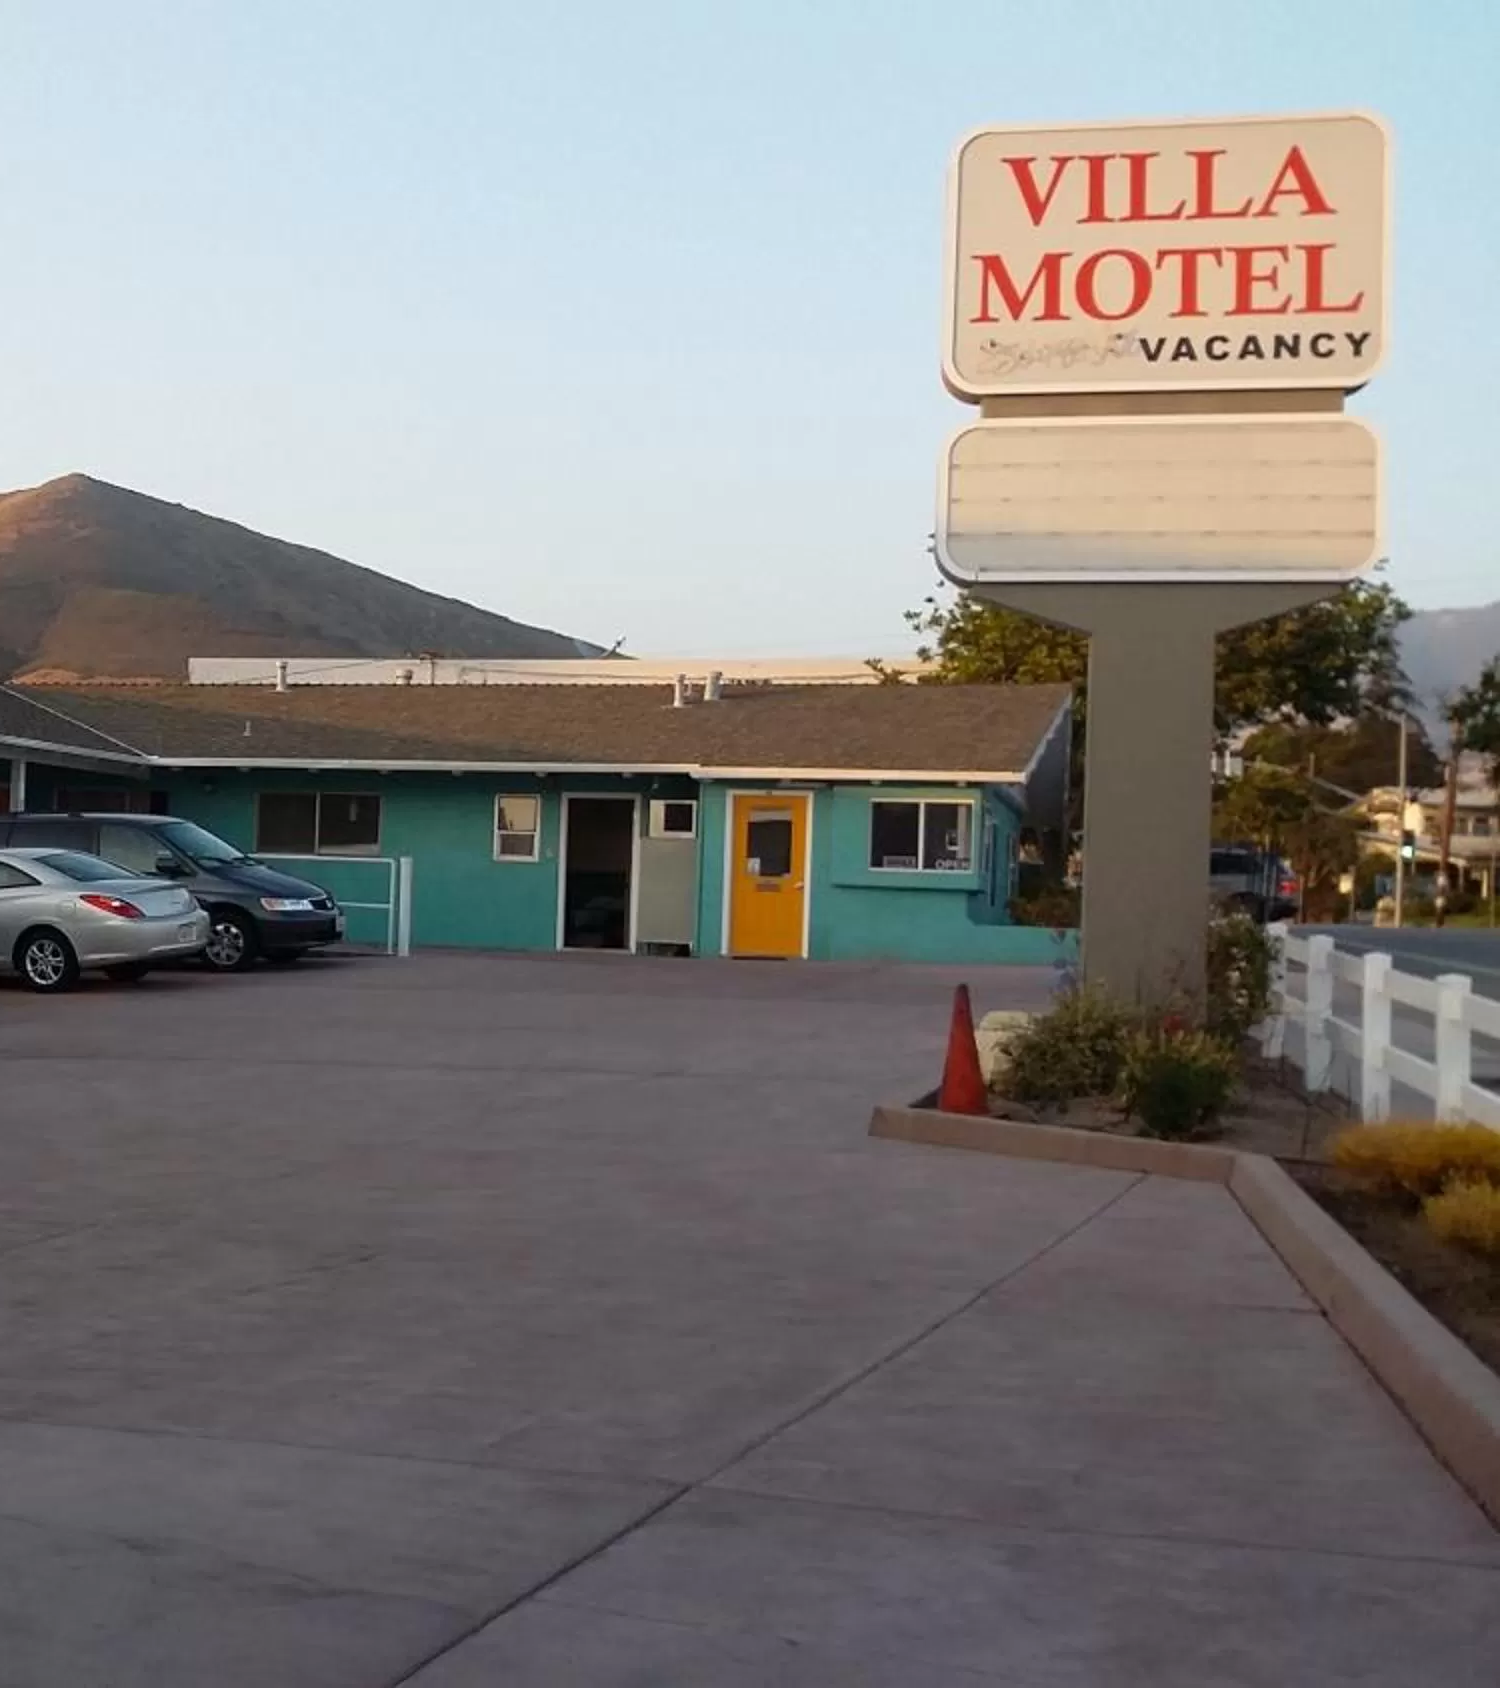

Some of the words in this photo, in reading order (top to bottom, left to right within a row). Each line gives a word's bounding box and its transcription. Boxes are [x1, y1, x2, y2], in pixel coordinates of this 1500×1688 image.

[1001, 145, 1338, 227] VILLA
[969, 243, 1365, 323] MOTEL
[1139, 332, 1371, 362] VACANCY
